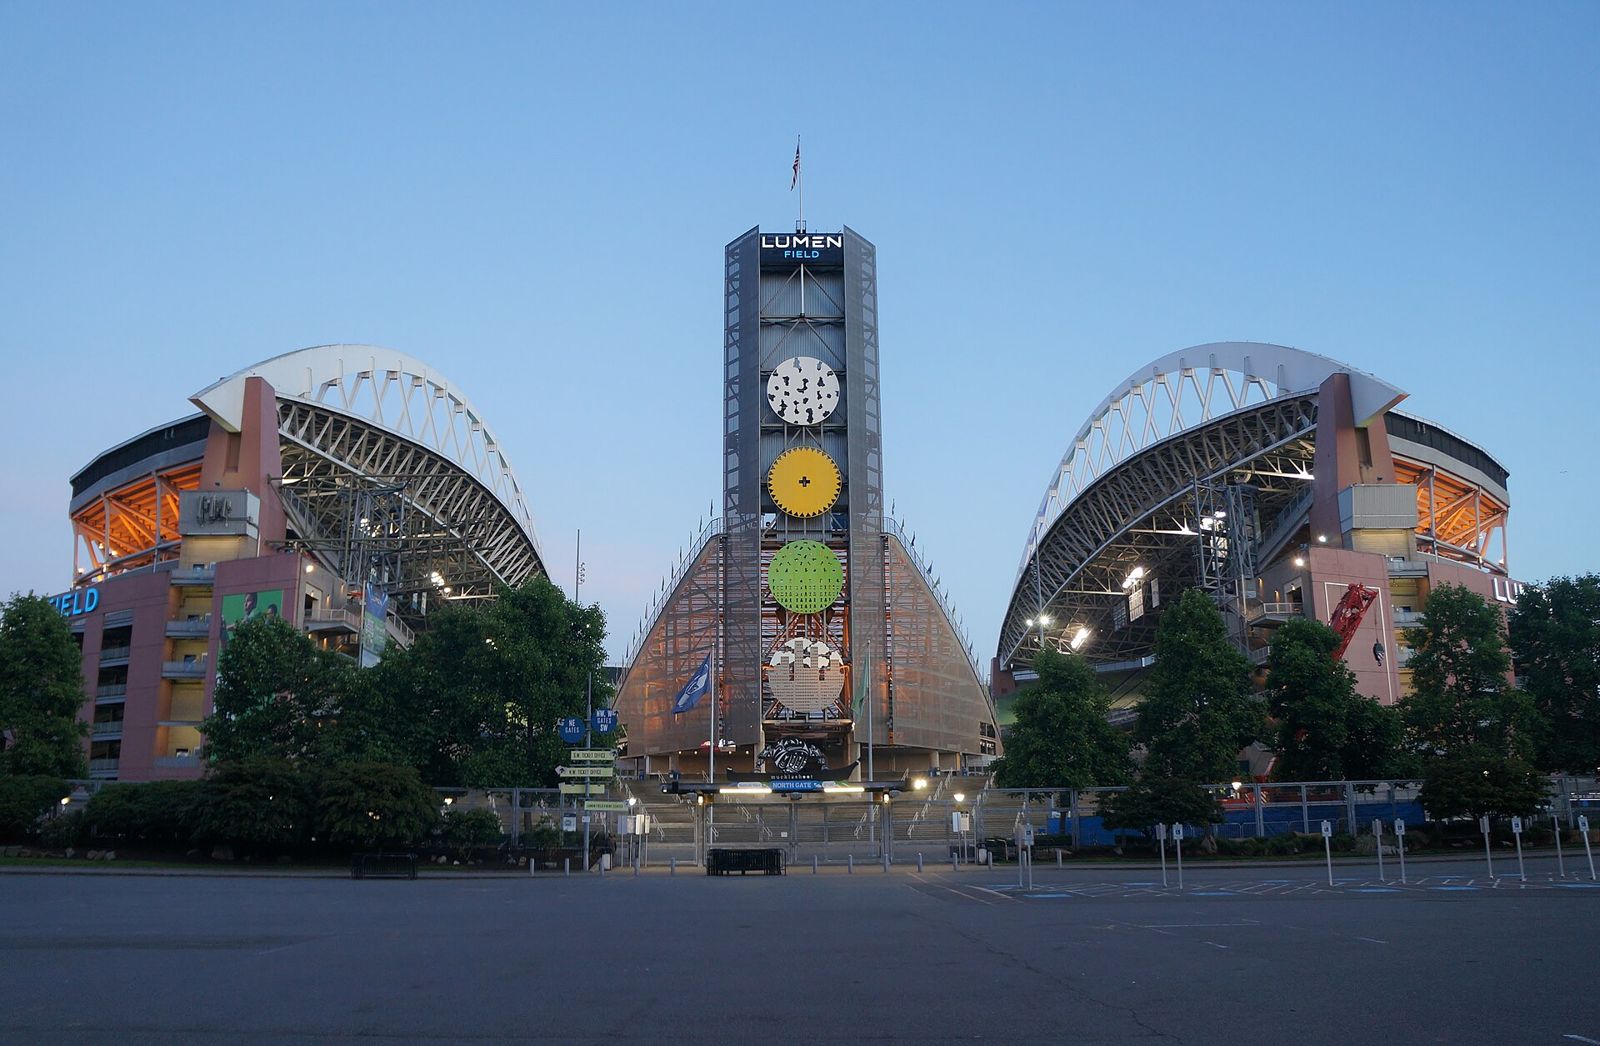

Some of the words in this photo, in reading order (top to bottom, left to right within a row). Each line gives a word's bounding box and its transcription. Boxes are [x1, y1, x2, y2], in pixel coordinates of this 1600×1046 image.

[762, 236, 842, 248] LUMEN
[784, 250, 820, 259] FIELD
[568, 719, 575, 727] NE
[600, 723, 609, 732] SW
